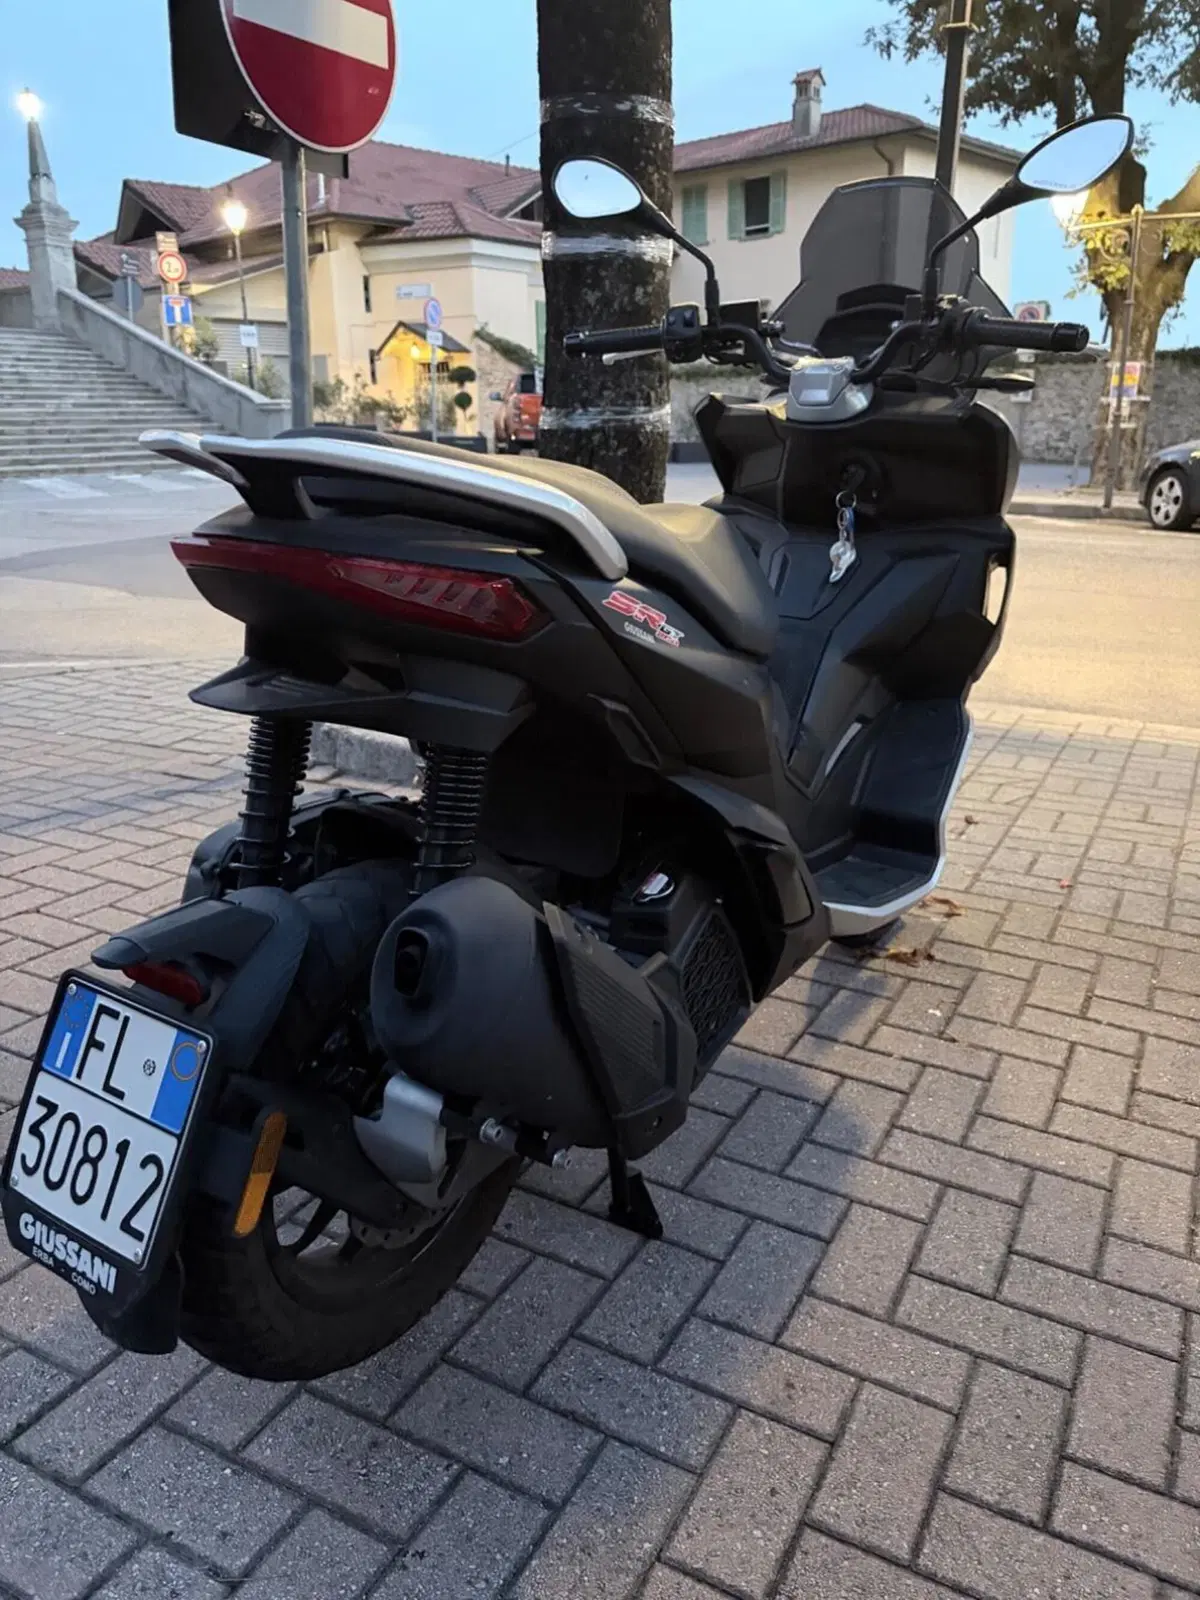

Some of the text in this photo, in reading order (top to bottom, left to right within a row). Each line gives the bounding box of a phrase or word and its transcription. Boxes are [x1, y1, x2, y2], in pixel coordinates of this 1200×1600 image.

[602, 590, 667, 632] SR
[76, 1003, 131, 1101] FL
[20, 1095, 164, 1243] 30812
[19, 1212, 118, 1295] GIUSSANI
[32, 1245, 55, 1268] ERBA
[71, 1271, 97, 1296] COMO
